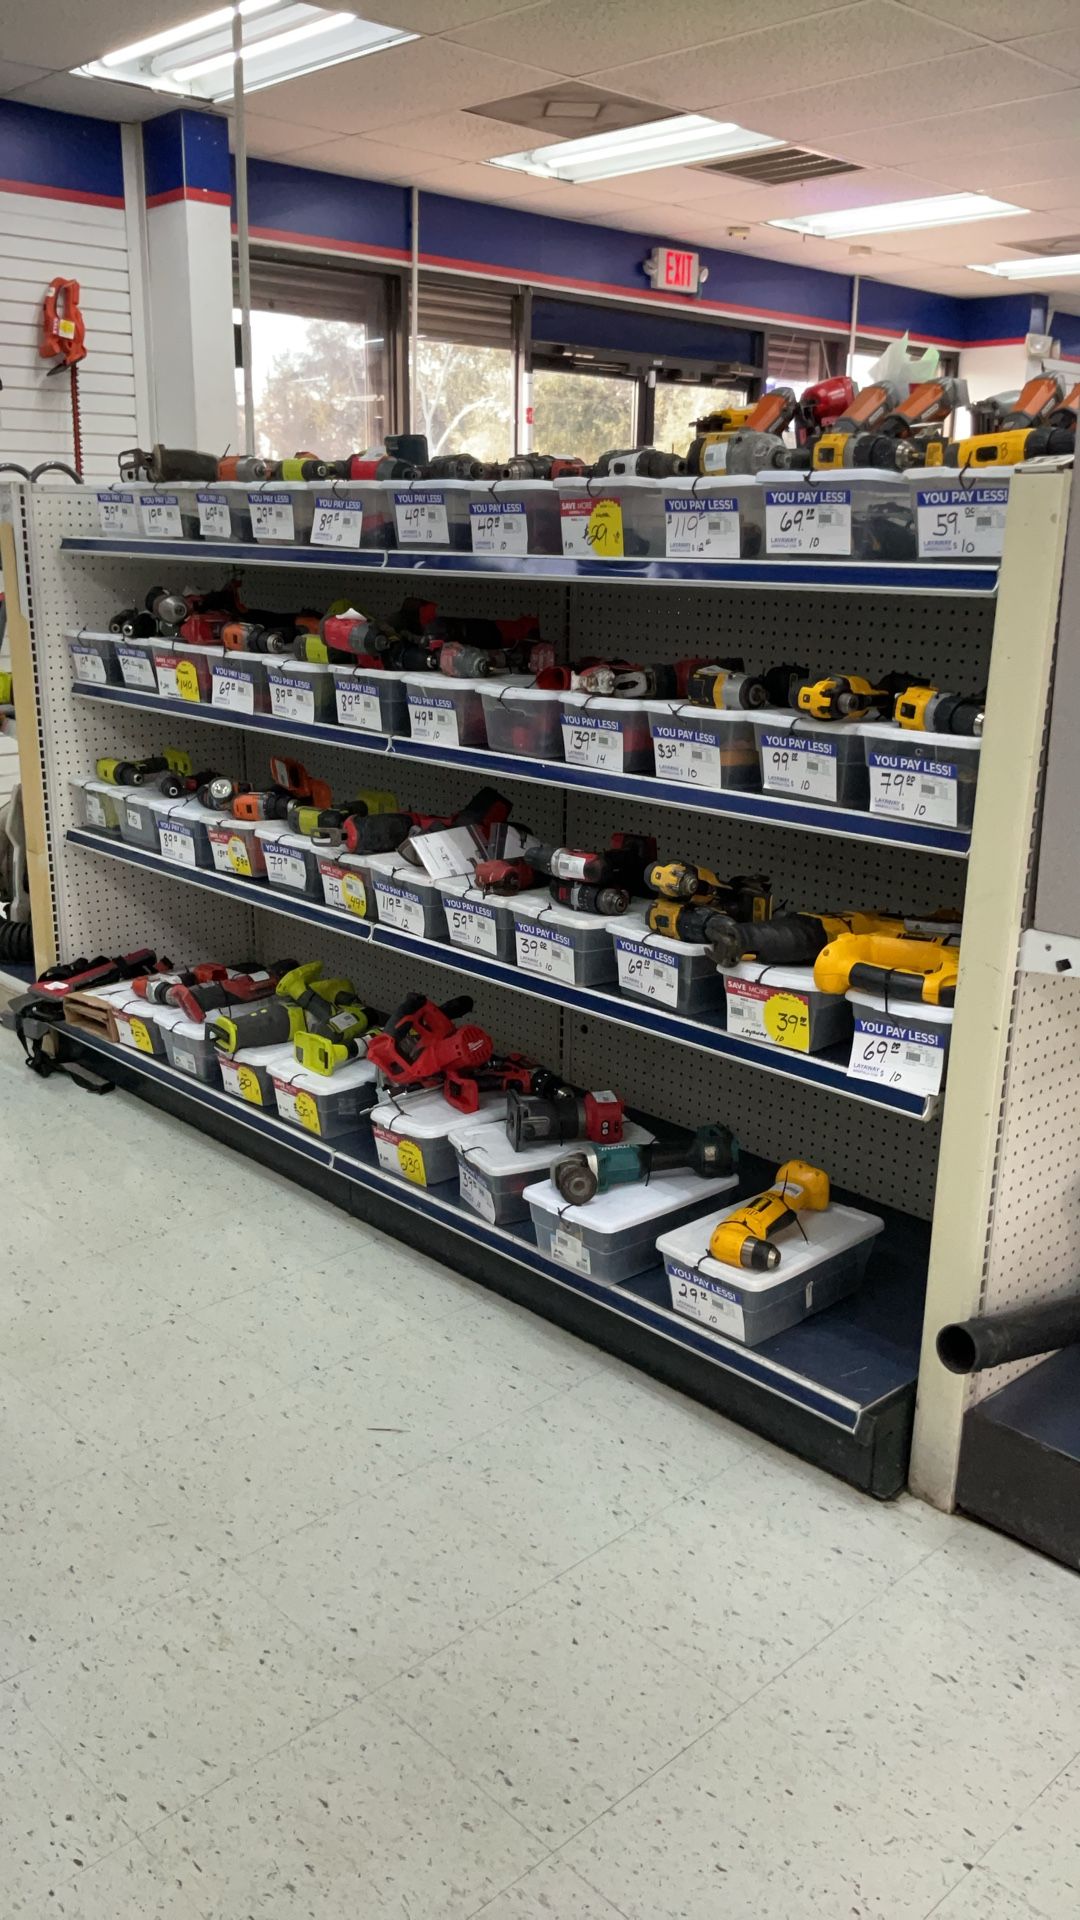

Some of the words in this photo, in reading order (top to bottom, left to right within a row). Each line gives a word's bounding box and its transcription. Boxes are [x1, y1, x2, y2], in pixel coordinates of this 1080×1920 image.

[666, 251, 693, 287] EXIT
[397, 494, 413, 503] YOU
[414, 494, 426, 503] PAY
[426, 494, 442, 503] LESS!
[770, 491, 795, 504] YOU
[797, 491, 819, 503] PAY
[820, 490, 847, 503] LESS!
[922, 491, 948, 504] YOU
[951, 490, 975, 503] PAY
[976, 488, 1008, 502] LESS!
[319, 498, 332, 508] YOU
[333, 499, 344, 508] PAY
[345, 500, 361, 510] LESS!
[471, 503, 487, 513] YOU
[488, 503, 502, 513] PAY
[502, 503, 523, 513] LESS!
[561, 502, 576, 510] SAVE
[668, 499, 688, 510] YOU
[689, 499, 706, 510] PAY
[707, 499, 734, 510] LESS!
[808, 536, 820, 549] 10
[961, 538, 975, 554] 10
[215, 666, 228, 676] YOU
[228, 670, 237, 678] PAY
[269, 674, 282, 683] YOU
[282, 676, 294, 686] PAY
[337, 681, 351, 690] YOU
[351, 682, 363, 692] PAY
[363, 684, 377, 694] LESS!
[408, 695, 422, 705] YOU
[422, 696, 435, 706] PAY
[435, 698, 452, 708] LESS!
[563, 714, 580, 725] YOU
[581, 716, 597, 727] PAY
[597, 718, 619, 731] LESS!
[656, 726, 677, 738] YOU
[677, 728, 694, 741] PAY
[694, 730, 716, 745] LESS!
[765, 735, 787, 747] YOU
[788, 737, 806, 750] PAY
[807, 739, 832, 755] LESS!
[596, 752, 607, 765] 14
[874, 754, 898, 768] YOU
[900, 757, 922, 771] PAY
[923, 760, 953, 777] LESS!
[687, 767, 698, 779] 10
[800, 779, 811, 791] 10
[913, 802, 927, 817] 10
[265, 843, 279, 853] YOU
[279, 846, 290, 856] PAY
[376, 882, 390, 893] YOU
[389, 886, 401, 897] PAY
[401, 890, 420, 903] LESS!
[446, 898, 461, 909] YOU
[461, 902, 475, 912] PAY
[474, 905, 492, 918] LESS!
[518, 922, 535, 935] YOU
[535, 927, 551, 939] PAY
[551, 931, 571, 947] LESS!
[619, 939, 637, 953] YOU
[638, 945, 653, 959] PAY
[654, 950, 675, 966] LESS!
[647, 985, 656, 995] 10
[727, 979, 747, 991] SAVE
[748, 985, 769, 996] MORE
[860, 1019, 884, 1035] YOU
[885, 1025, 907, 1040] PAY
[907, 1029, 940, 1047] LESS!
[853, 1062, 881, 1073] LAYAWAY
[888, 1070, 903, 1083] 10
[671, 1265, 692, 1281] YOU
[693, 1276, 711, 1290] PAY
[711, 1282, 737, 1302] LESS!
[708, 1314, 718, 1324] 10
